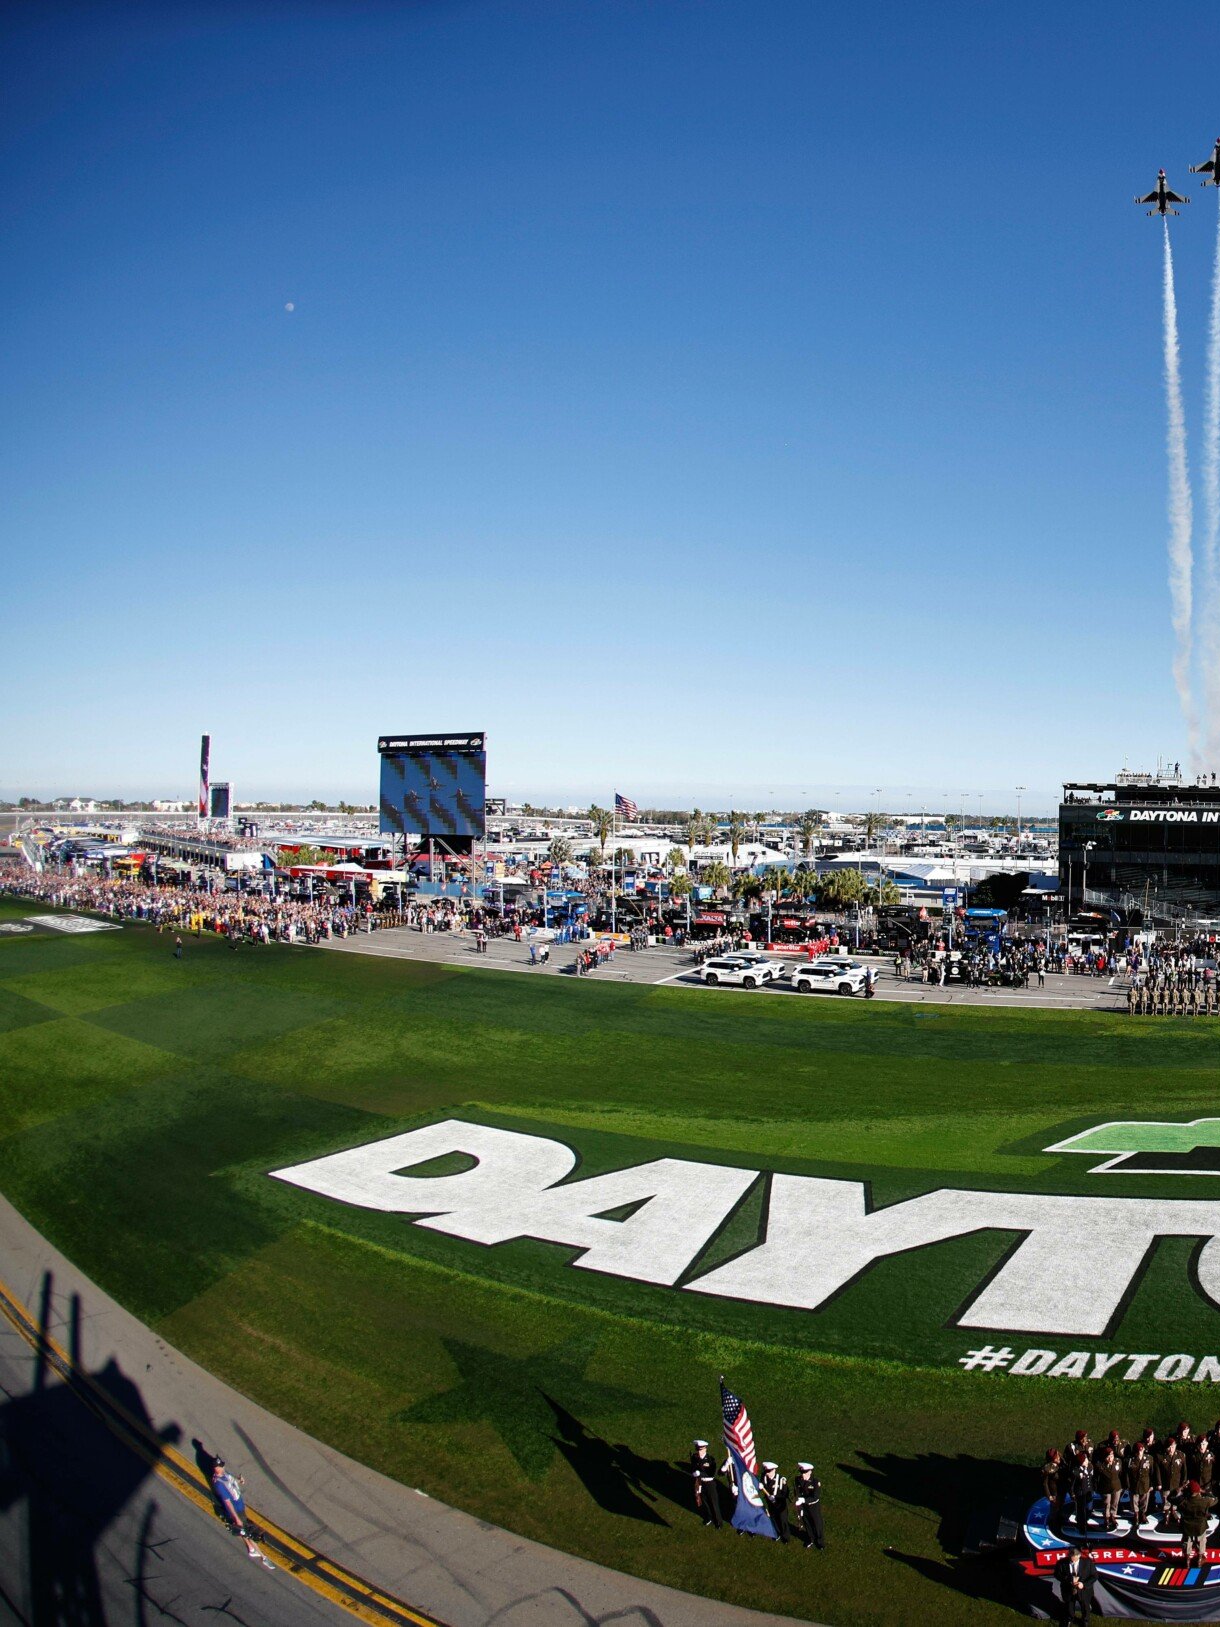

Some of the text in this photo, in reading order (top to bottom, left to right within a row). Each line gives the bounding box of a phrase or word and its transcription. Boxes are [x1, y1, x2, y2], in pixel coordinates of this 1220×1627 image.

[1129, 810, 1198, 822] DAYTONA
[1043, 1552, 1067, 1562] TH
[1091, 1550, 1147, 1560] GREAT
